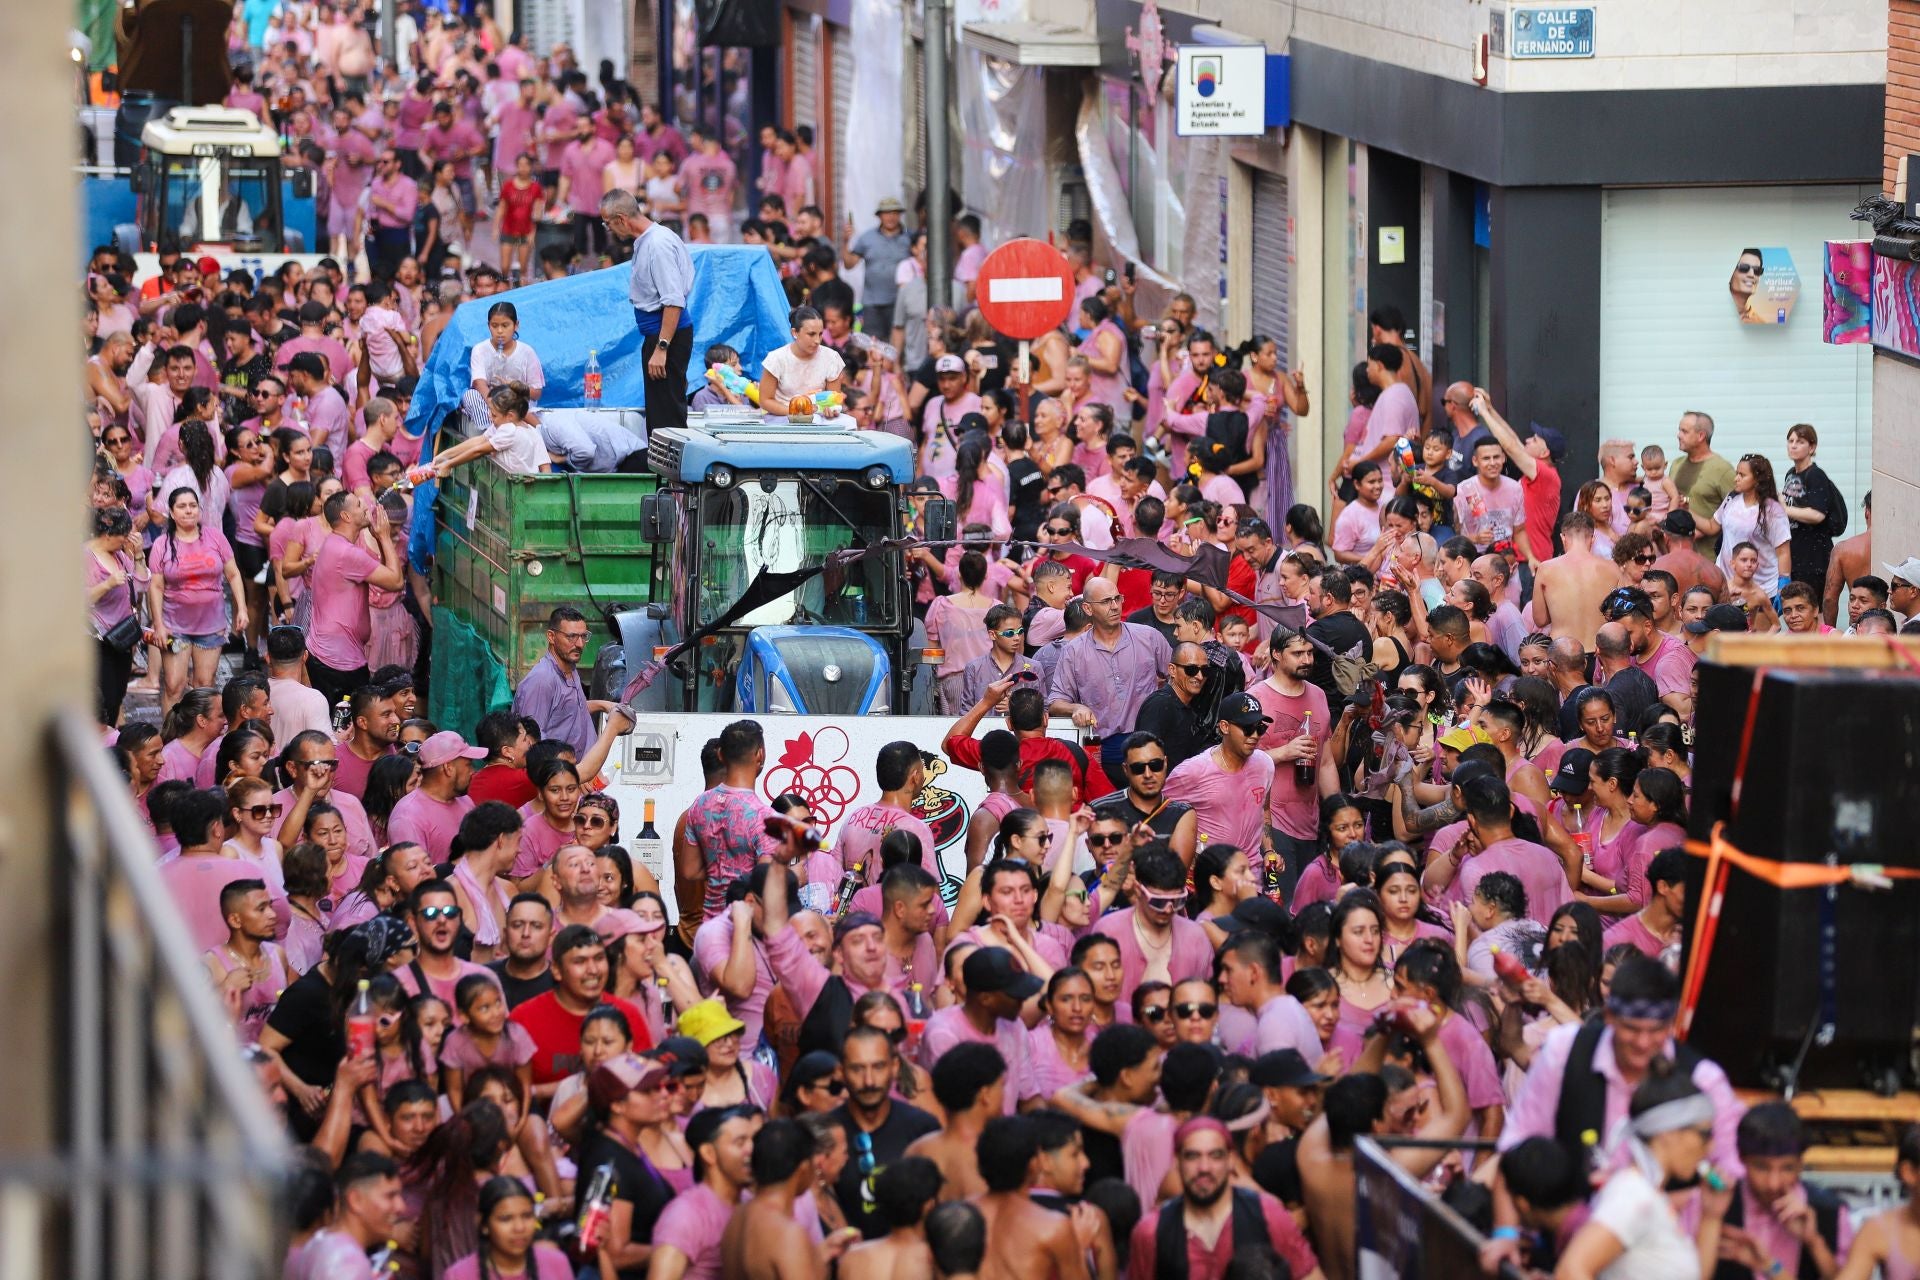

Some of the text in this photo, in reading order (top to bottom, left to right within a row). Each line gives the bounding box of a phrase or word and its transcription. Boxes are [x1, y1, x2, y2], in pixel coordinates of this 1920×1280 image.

[1537, 11, 1577, 24] CALLE
[1548, 27, 1566, 39] DE
[1517, 40, 1590, 53] FERNANDO III
[848, 807, 906, 831] BREAK
